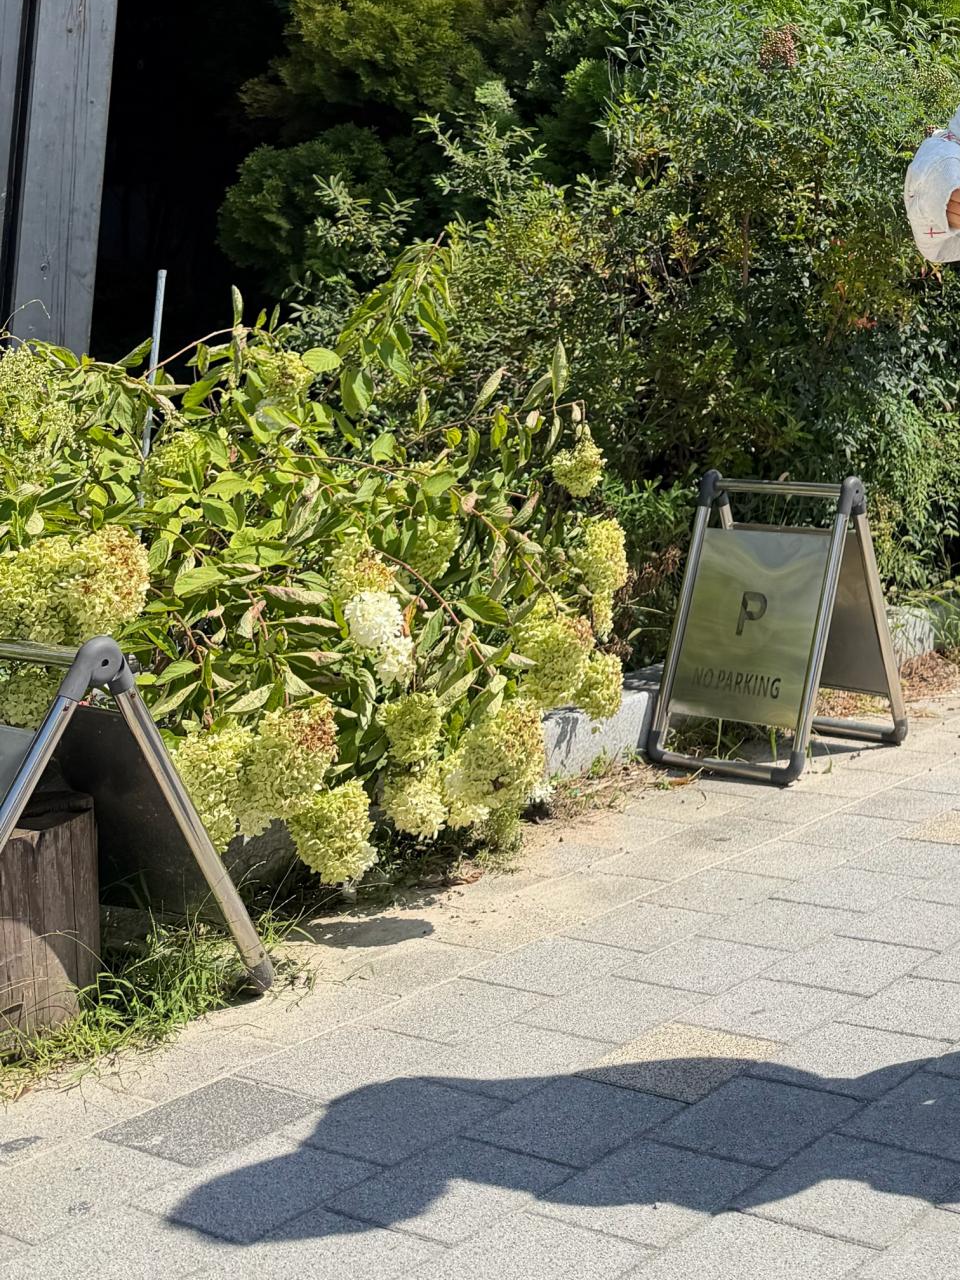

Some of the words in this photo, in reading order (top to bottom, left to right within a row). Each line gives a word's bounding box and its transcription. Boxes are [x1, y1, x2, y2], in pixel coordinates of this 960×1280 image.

[735, 591, 768, 636] P
[691, 667, 714, 689] NO
[715, 669, 781, 699] PARKING
